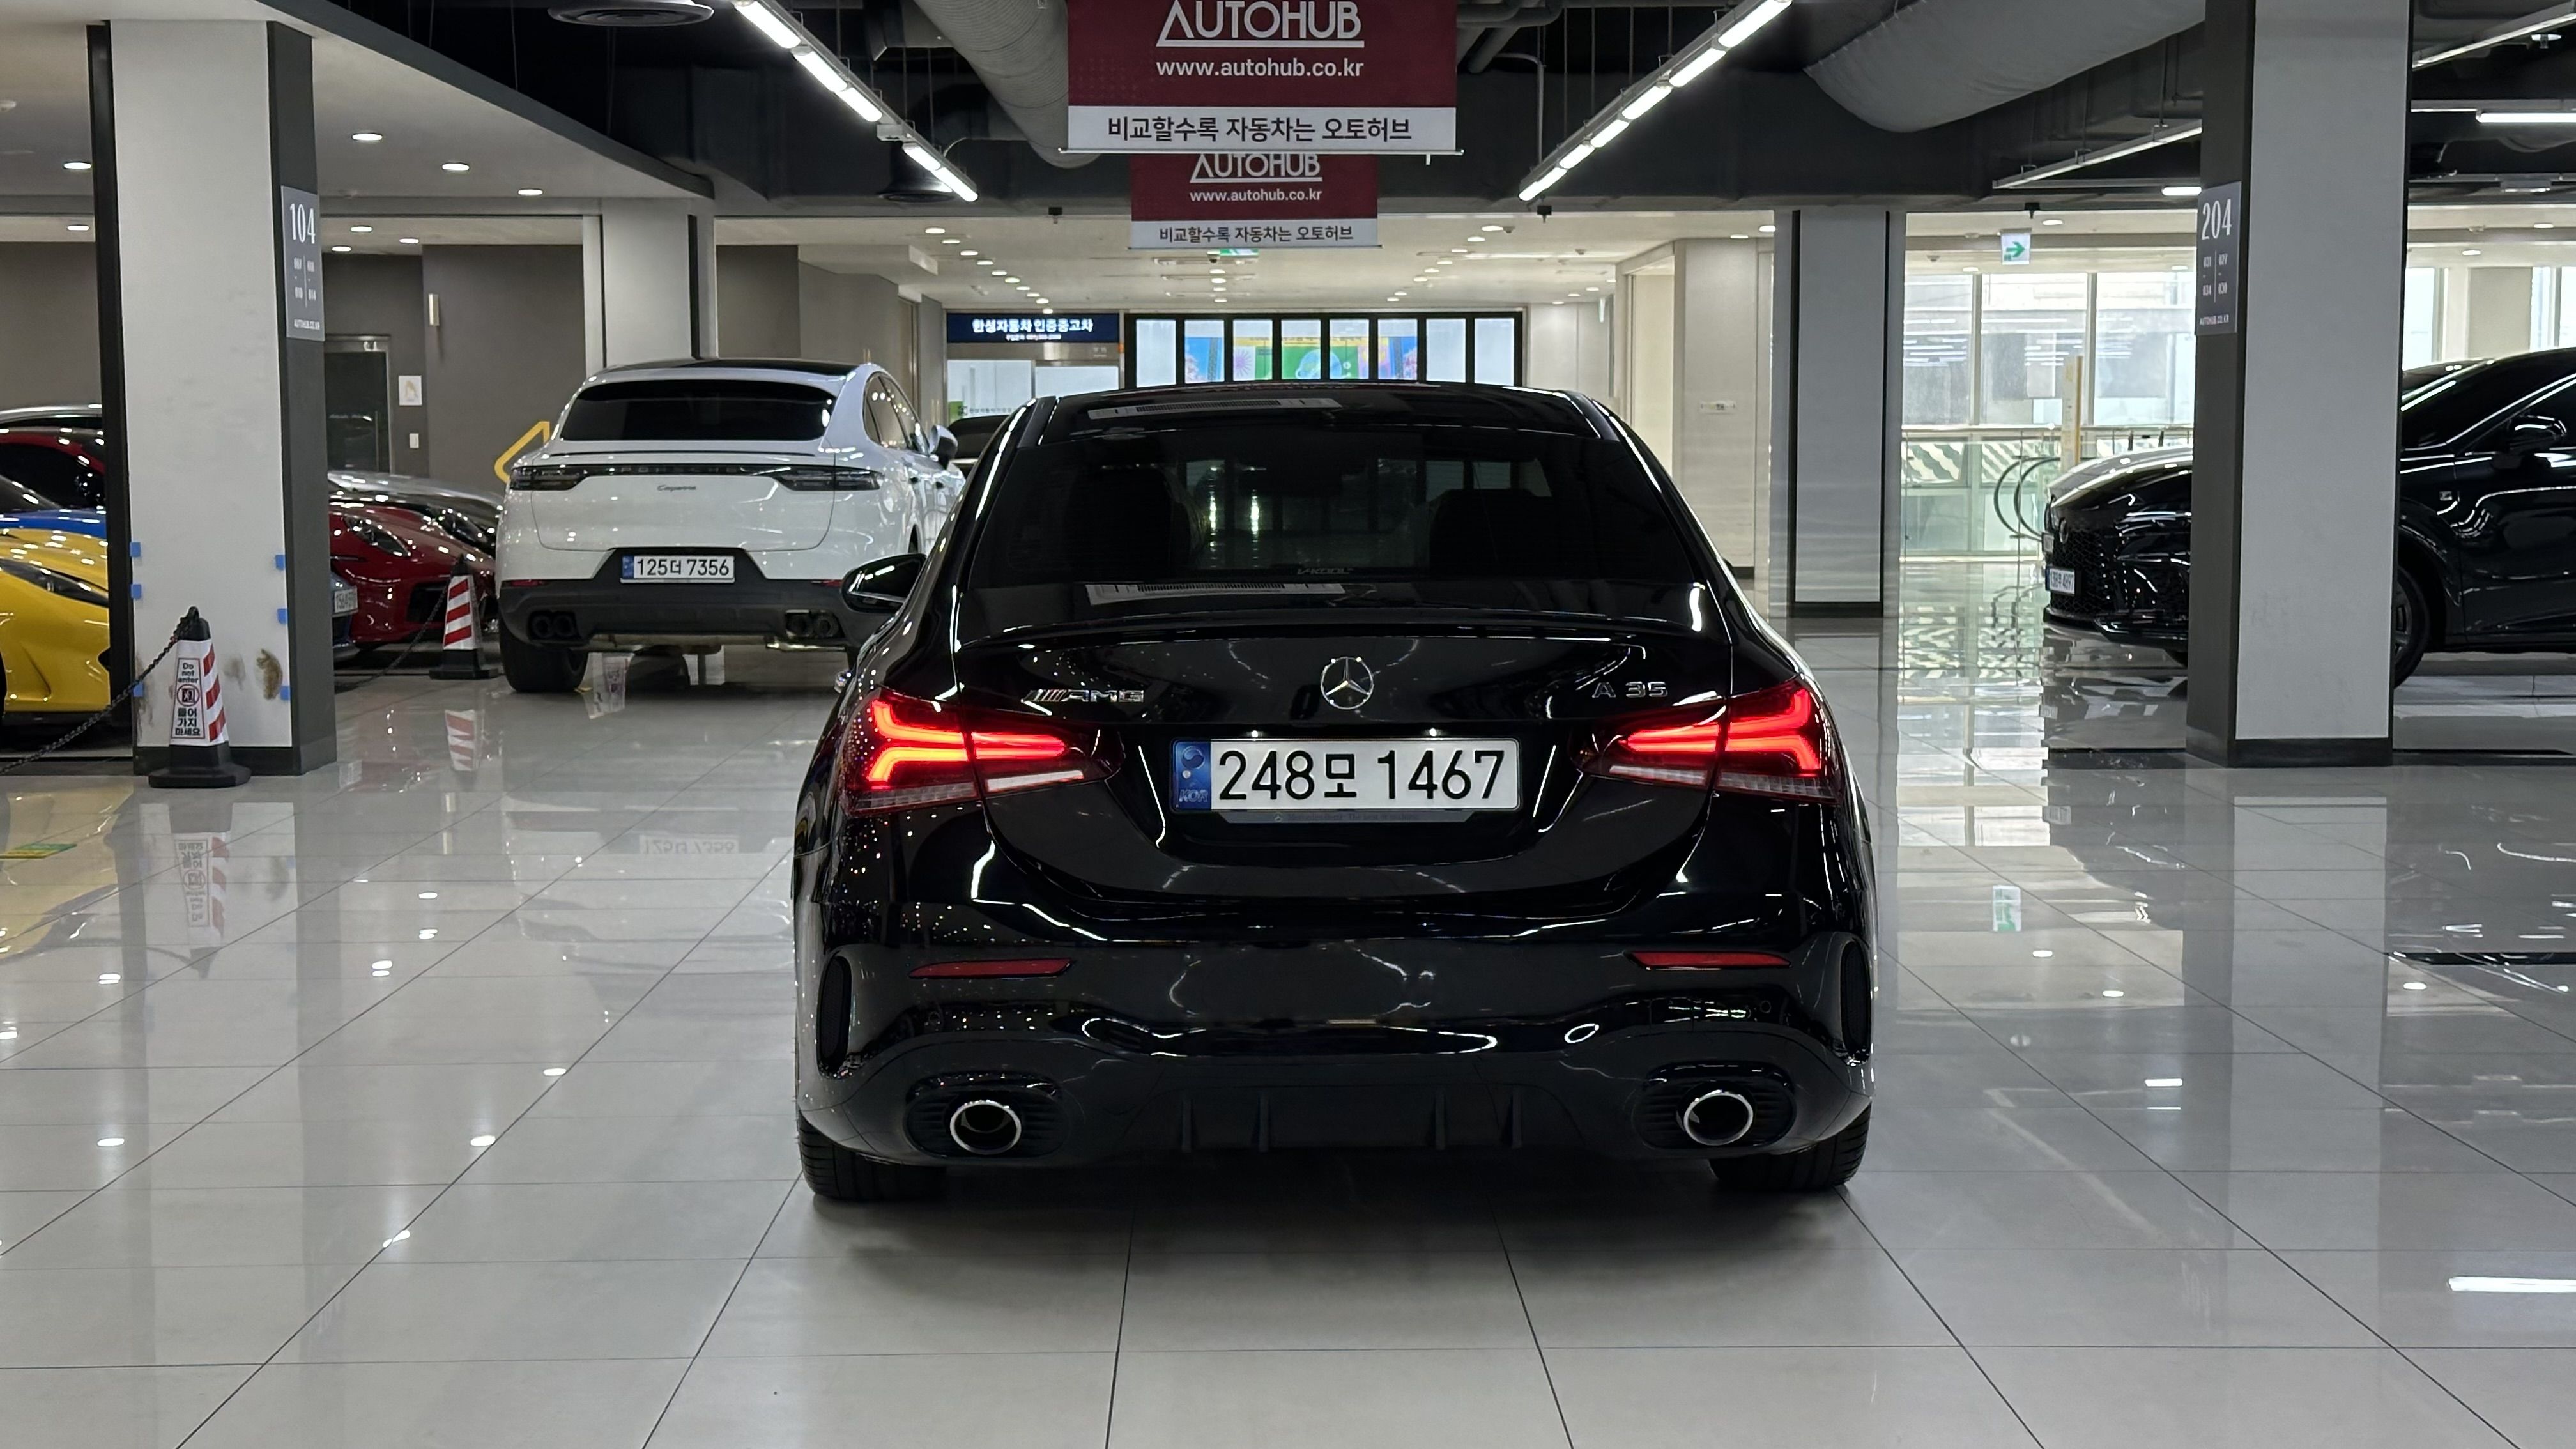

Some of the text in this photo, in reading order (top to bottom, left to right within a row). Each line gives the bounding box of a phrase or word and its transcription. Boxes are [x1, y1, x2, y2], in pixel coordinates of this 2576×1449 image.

[1155, 0, 1365, 48] AUTOHUB
[1156, 57, 1364, 77] www.autohub.co.kr
[1108, 116, 1412, 142] 비교할수록 자동차는 오토허브
[1189, 153, 1323, 183] AUTOHUB
[1190, 188, 1322, 202] www.autohub.co.kr
[289, 203, 316, 244] 104
[2202, 199, 2232, 240] 204
[1160, 225, 1354, 243] 비교할수록 자동차는 오토허브
[637, 558, 730, 576] 125더 7356
[1060, 689, 1144, 702] AMG
[1591, 681, 1669, 698] A 35
[178, 717, 197, 727] 가지
[175, 728, 201, 736] 마세요
[1218, 750, 1505, 800] 248모 1467
[1179, 789, 1209, 802] KOR
